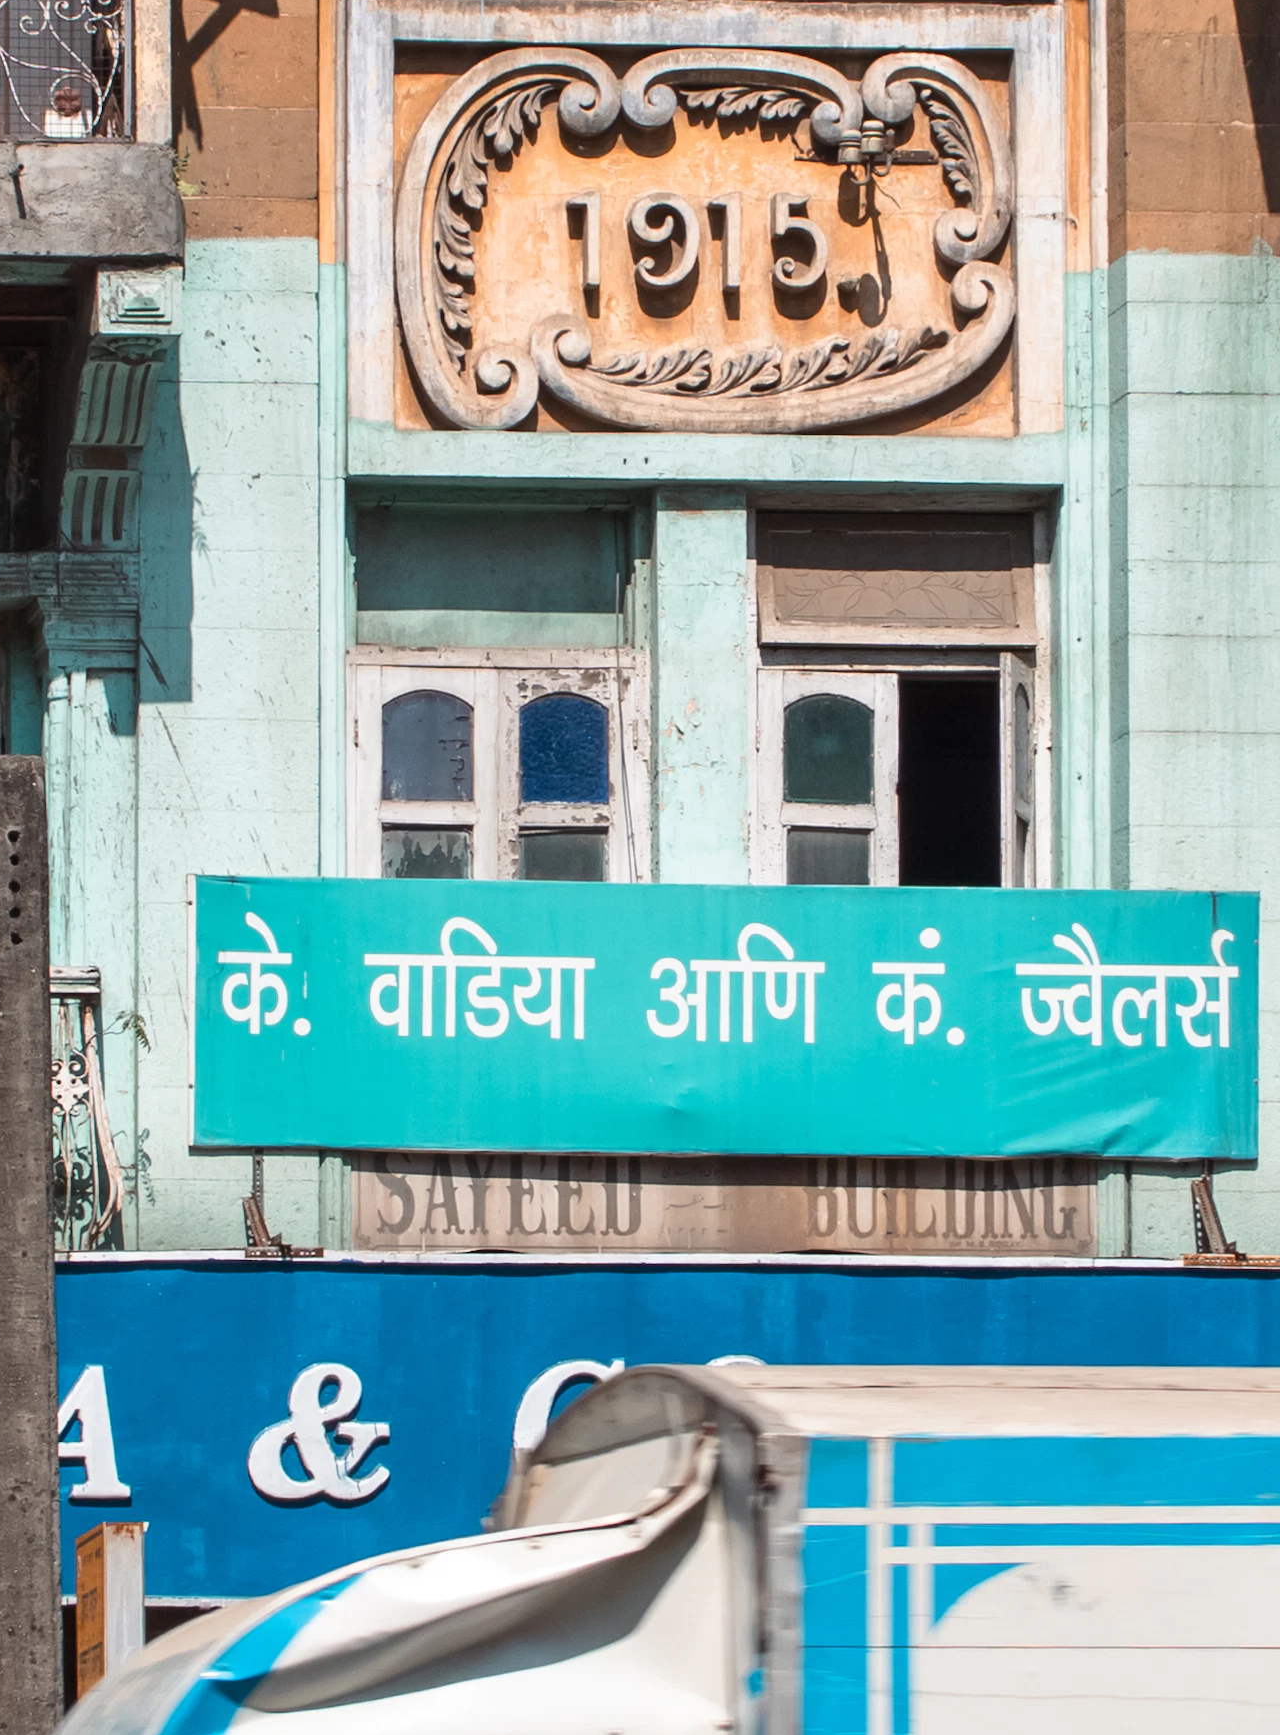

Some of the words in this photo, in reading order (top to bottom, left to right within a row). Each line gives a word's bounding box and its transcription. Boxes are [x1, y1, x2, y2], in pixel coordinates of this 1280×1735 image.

[565, 190, 828, 291] 1915
[217, 911, 311, 1037] के.
[363, 916, 596, 1041] वाडिया
[645, 922, 827, 1045] आणि
[871, 927, 966, 1046] कं.
[1015, 922, 1240, 1049] ज्वैलर्स
[375, 1153, 642, 1236] SAYEED
[803, 1157, 1077, 1240] BUILDING
[247, 1363, 390, 1501] &
